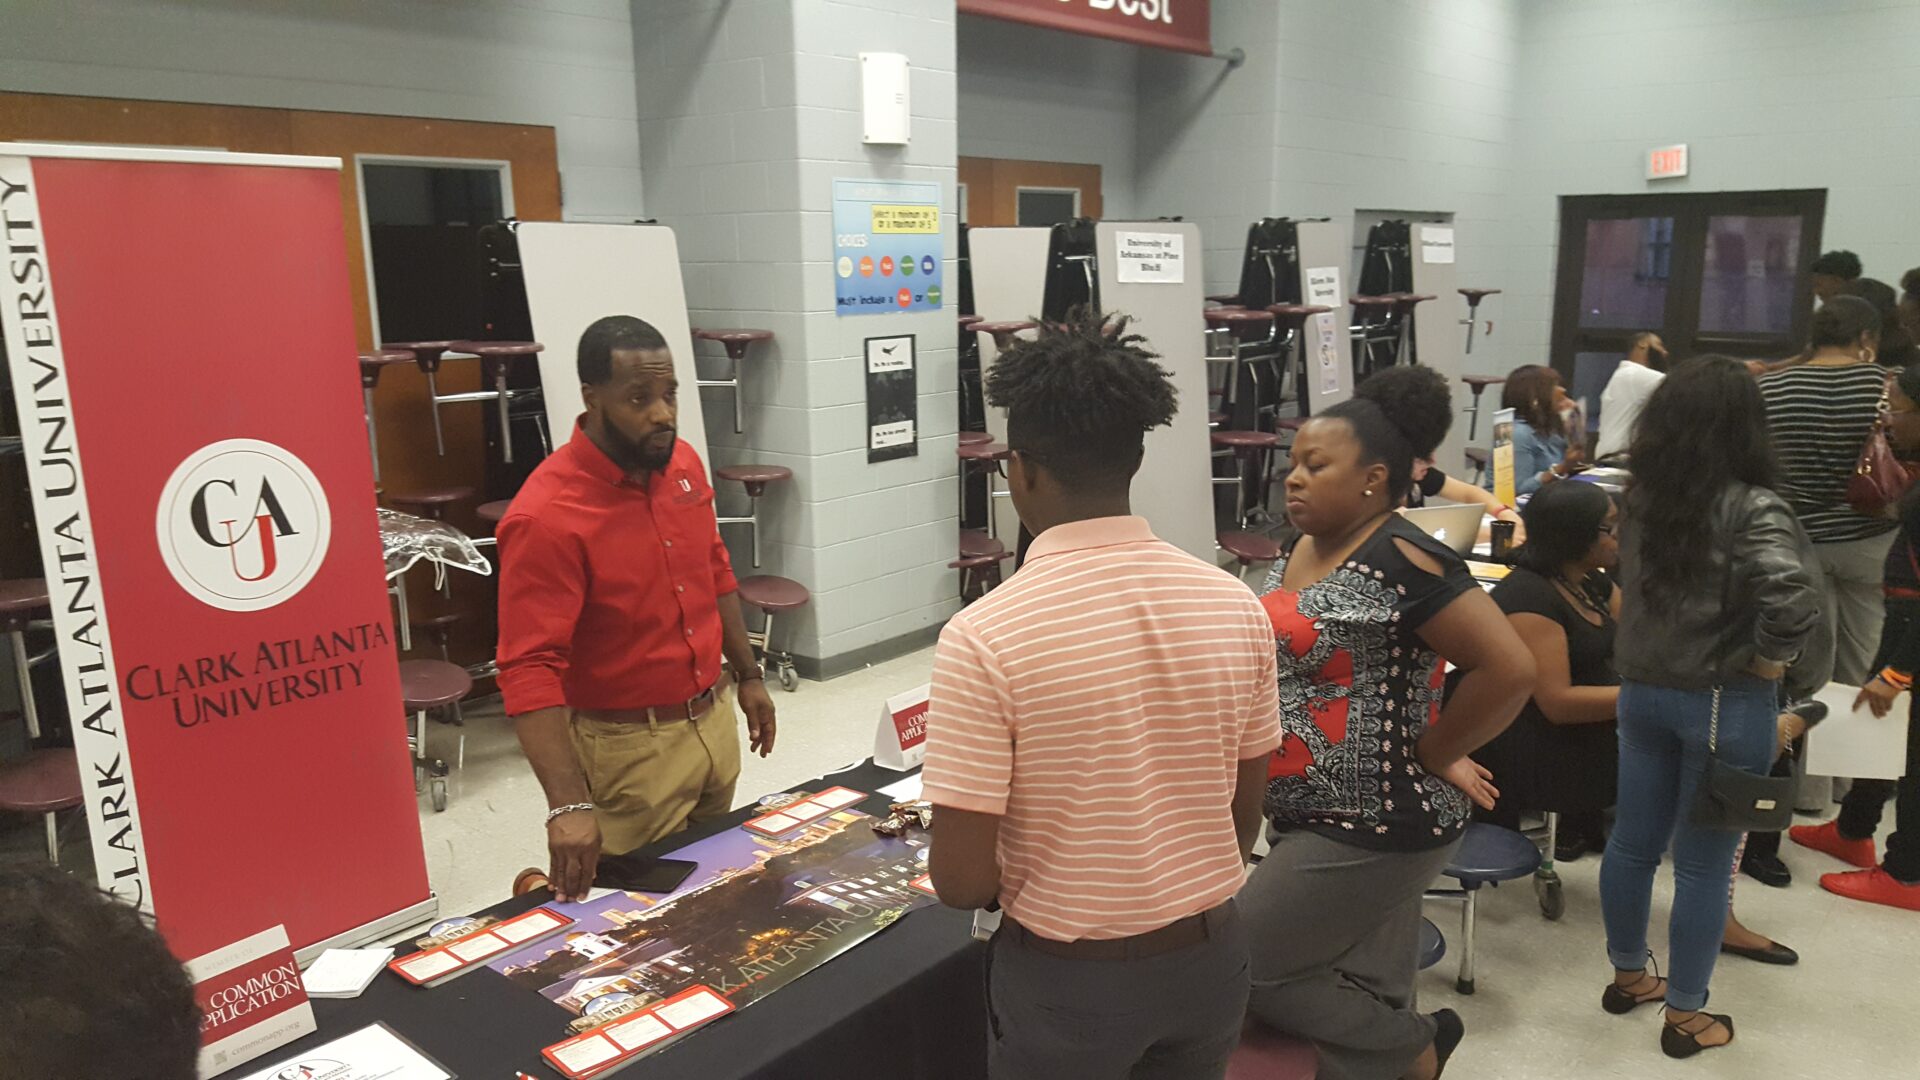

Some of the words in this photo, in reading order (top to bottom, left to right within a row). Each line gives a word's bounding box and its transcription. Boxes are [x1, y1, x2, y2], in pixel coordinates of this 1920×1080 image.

[1088, 0, 1172, 24] est
[1127, 238, 1162, 250] University
[0, 177, 78, 499] UNIVERSITY
[54, 511, 118, 738] ATLANTA
[125, 651, 244, 701] CLARK
[254, 621, 389, 675] ATLANTA
[172, 660, 364, 729] UNIVERSITY
[94, 752, 143, 911] CLARK
[738, 916, 856, 983] ATLANTA
[200, 976, 300, 1032] PPLICATION
[210, 961, 296, 1009] COMMON
